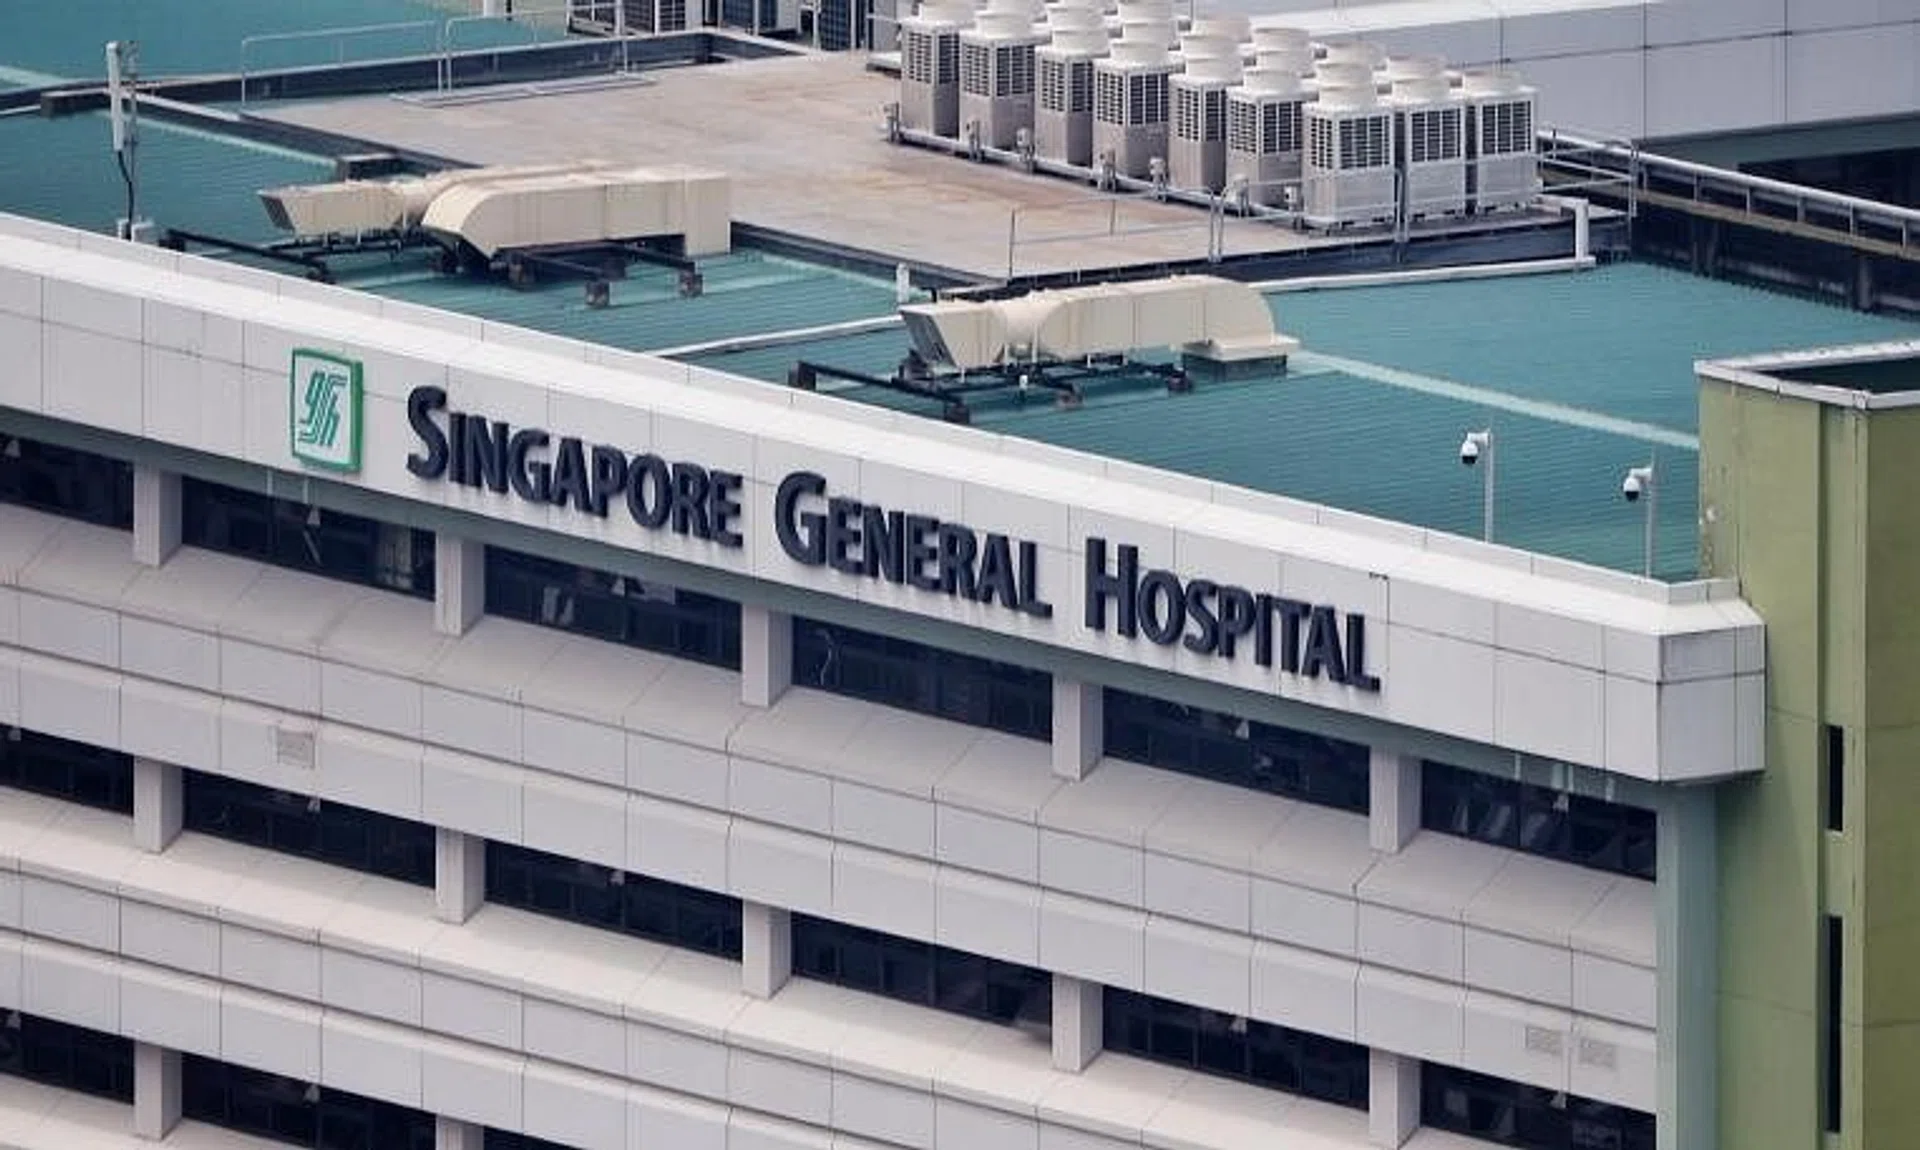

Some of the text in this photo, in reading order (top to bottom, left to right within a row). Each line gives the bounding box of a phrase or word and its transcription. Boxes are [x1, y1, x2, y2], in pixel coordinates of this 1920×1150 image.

[407, 385, 743, 547] SINGAPORE
[775, 471, 1052, 618] GENERAL
[1085, 536, 1381, 691] HOSPITAL
